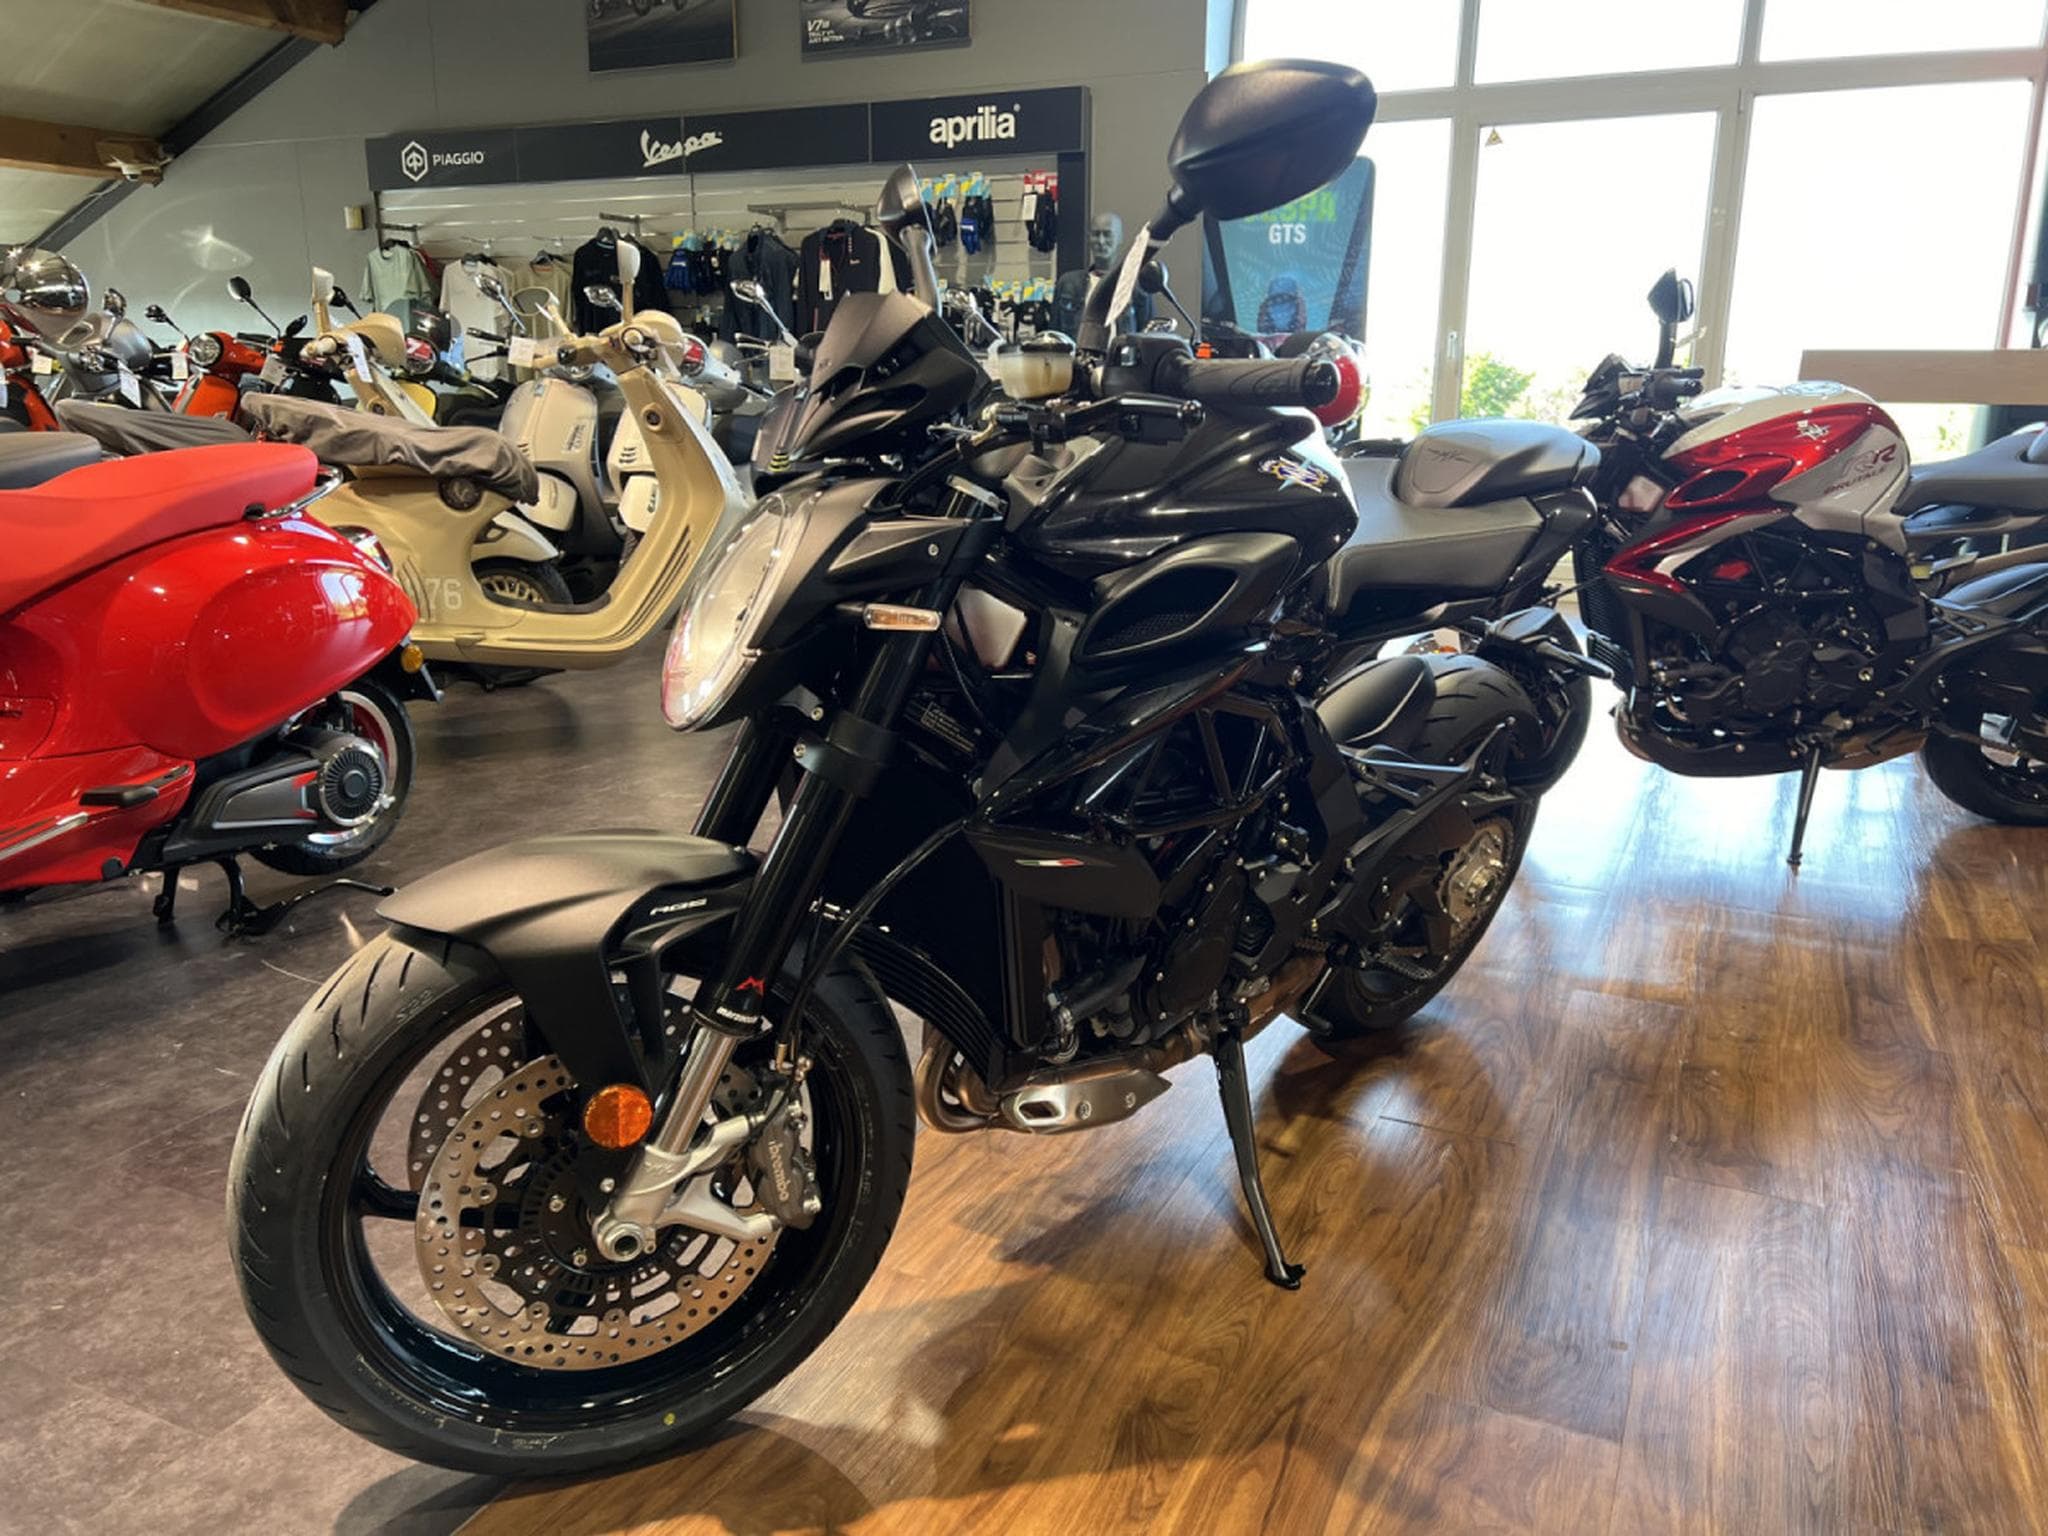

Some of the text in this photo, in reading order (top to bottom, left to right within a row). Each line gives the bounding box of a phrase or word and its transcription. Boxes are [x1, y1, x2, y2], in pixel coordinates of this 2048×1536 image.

[929, 105, 1016, 149] aprilia
[432, 151, 484, 166] PIAGGIO
[640, 129, 723, 168] Vespa
[1244, 191, 1338, 223] SPA
[1268, 223, 1307, 244] GTS
[425, 577, 462, 611] 76
[768, 1140, 792, 1201] brembo
